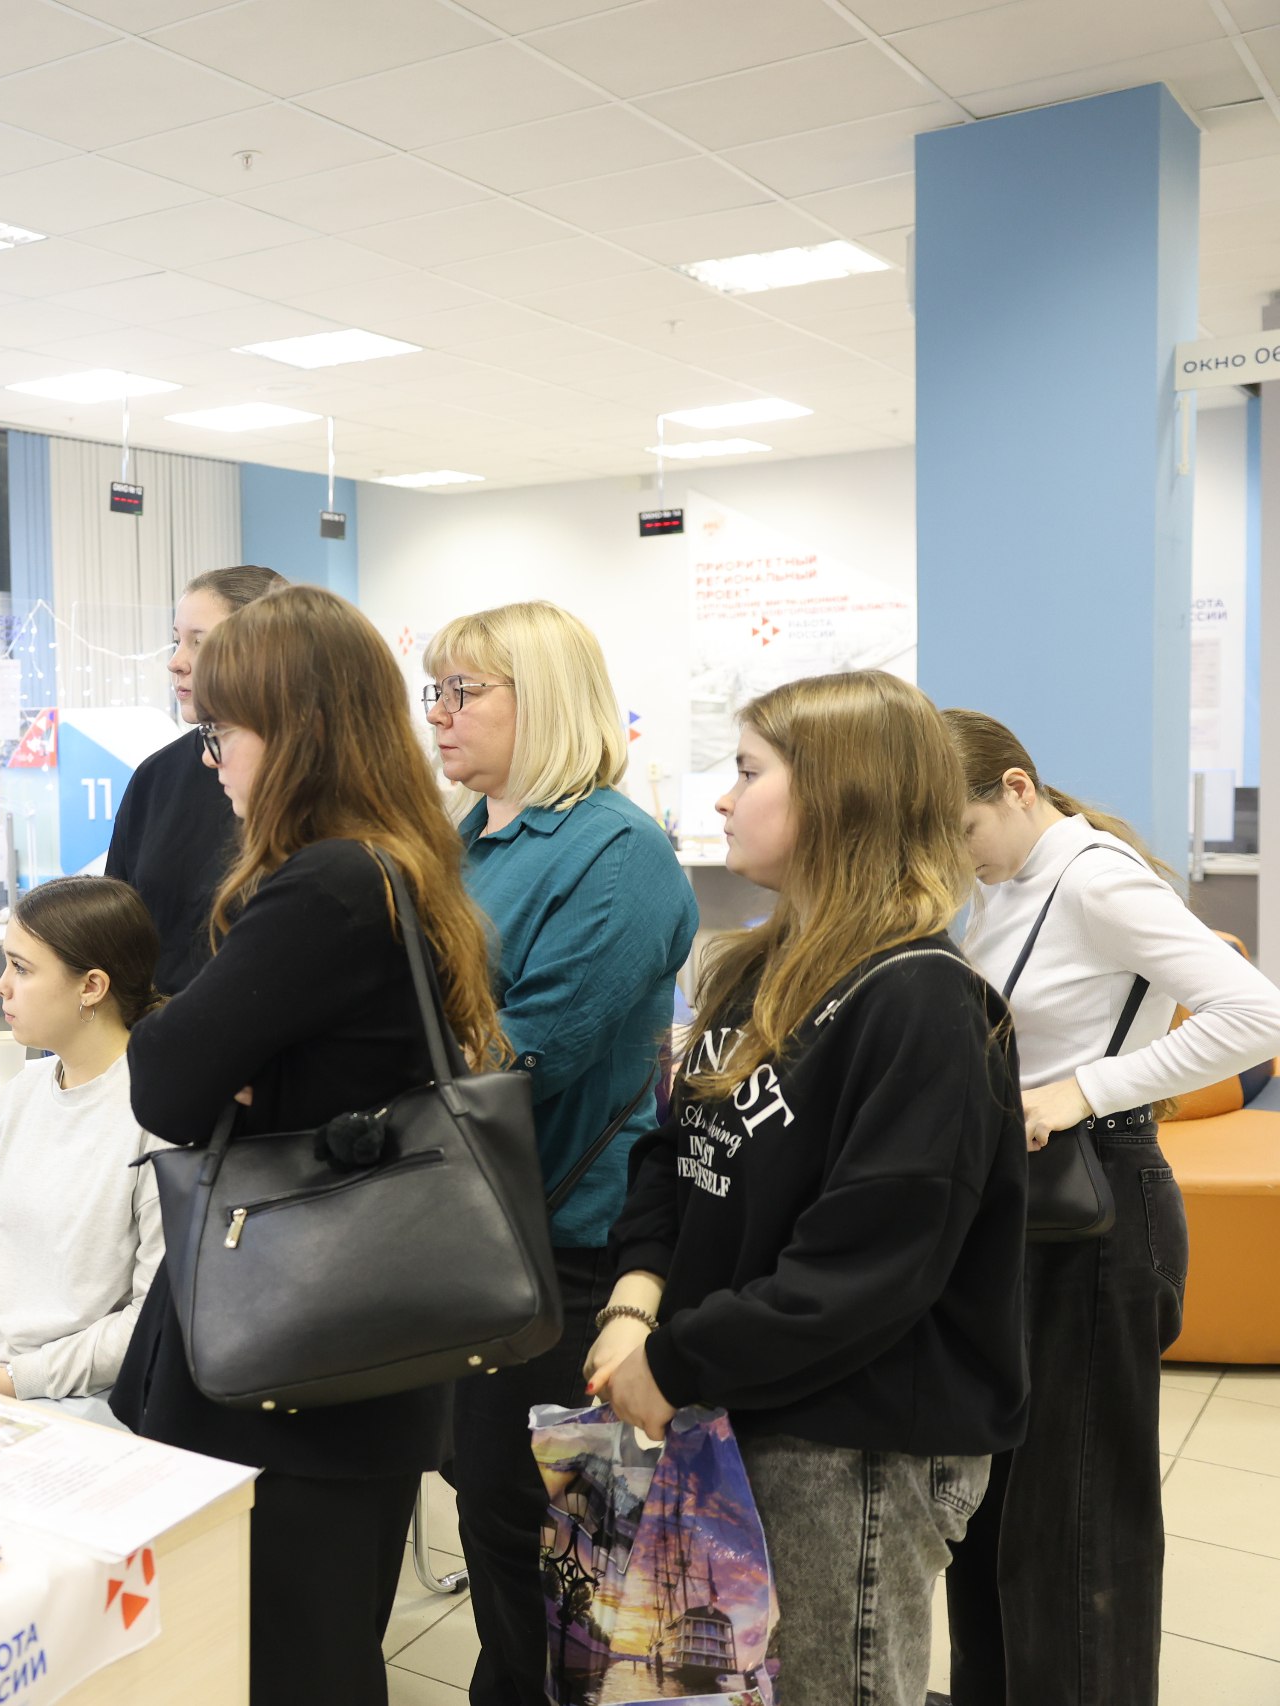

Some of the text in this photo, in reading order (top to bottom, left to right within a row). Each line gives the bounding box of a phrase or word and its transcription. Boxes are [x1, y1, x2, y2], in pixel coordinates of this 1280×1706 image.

[1183, 354, 1246, 373] ОКНО
[696, 570, 817, 586] РЕГИОНАЛЬНЫЙ
[697, 588, 750, 600] ПРОЕКТ
[81, 778, 112, 820] 11
